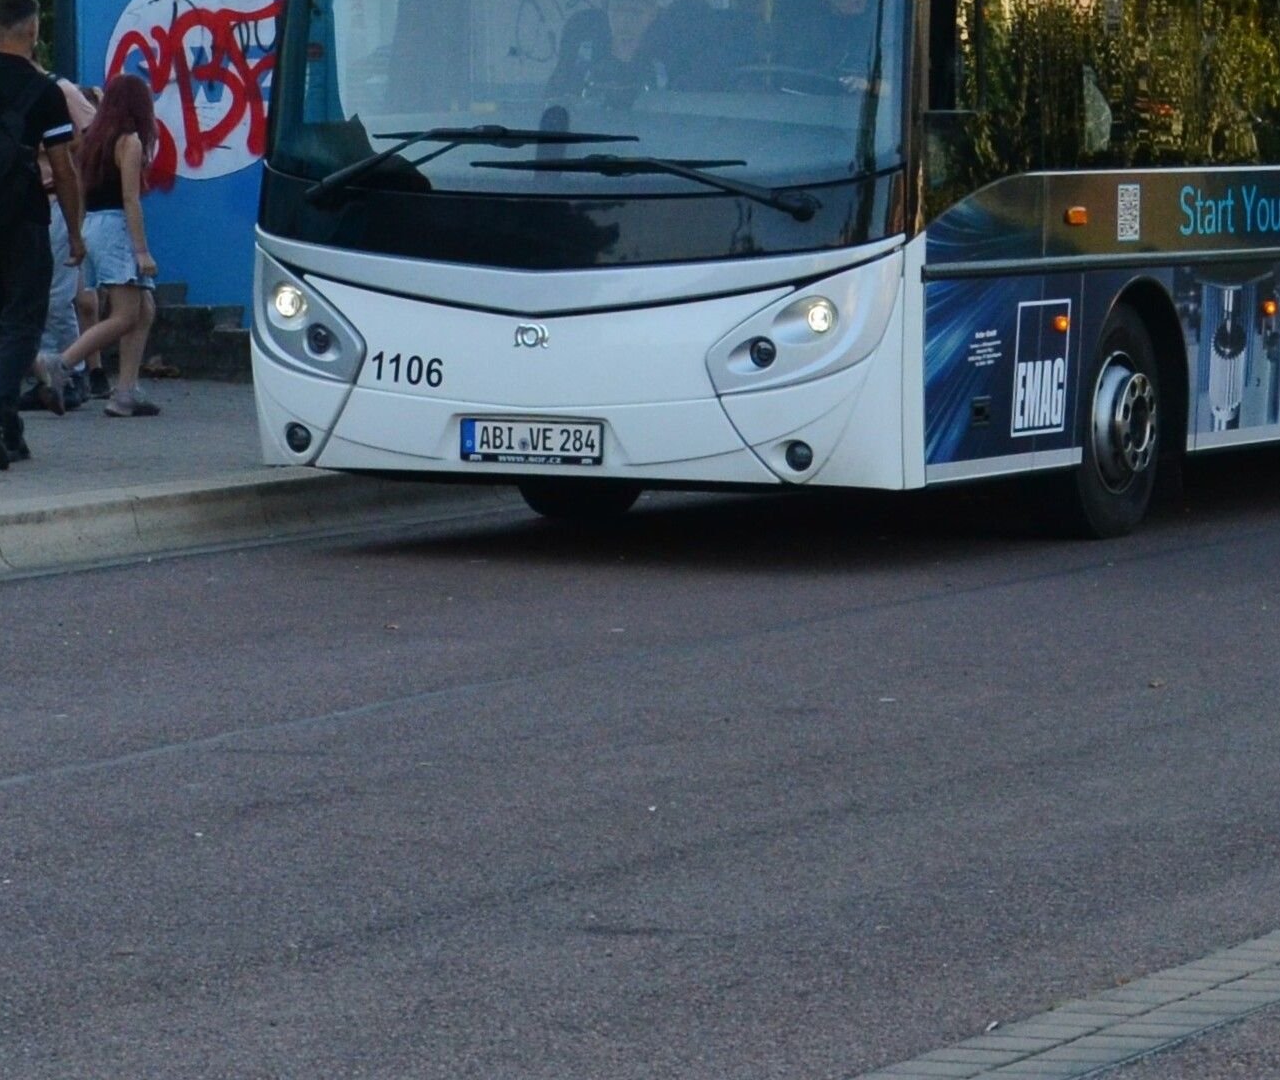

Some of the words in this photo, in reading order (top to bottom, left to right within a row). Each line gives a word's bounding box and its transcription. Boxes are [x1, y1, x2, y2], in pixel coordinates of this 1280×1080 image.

[1179, 185, 1235, 236] Start
[372, 351, 444, 388] 1106
[1015, 357, 1064, 429] EMAG
[479, 425, 515, 450] ABI
[529, 427, 554, 452] VE
[559, 428, 596, 453] 284
